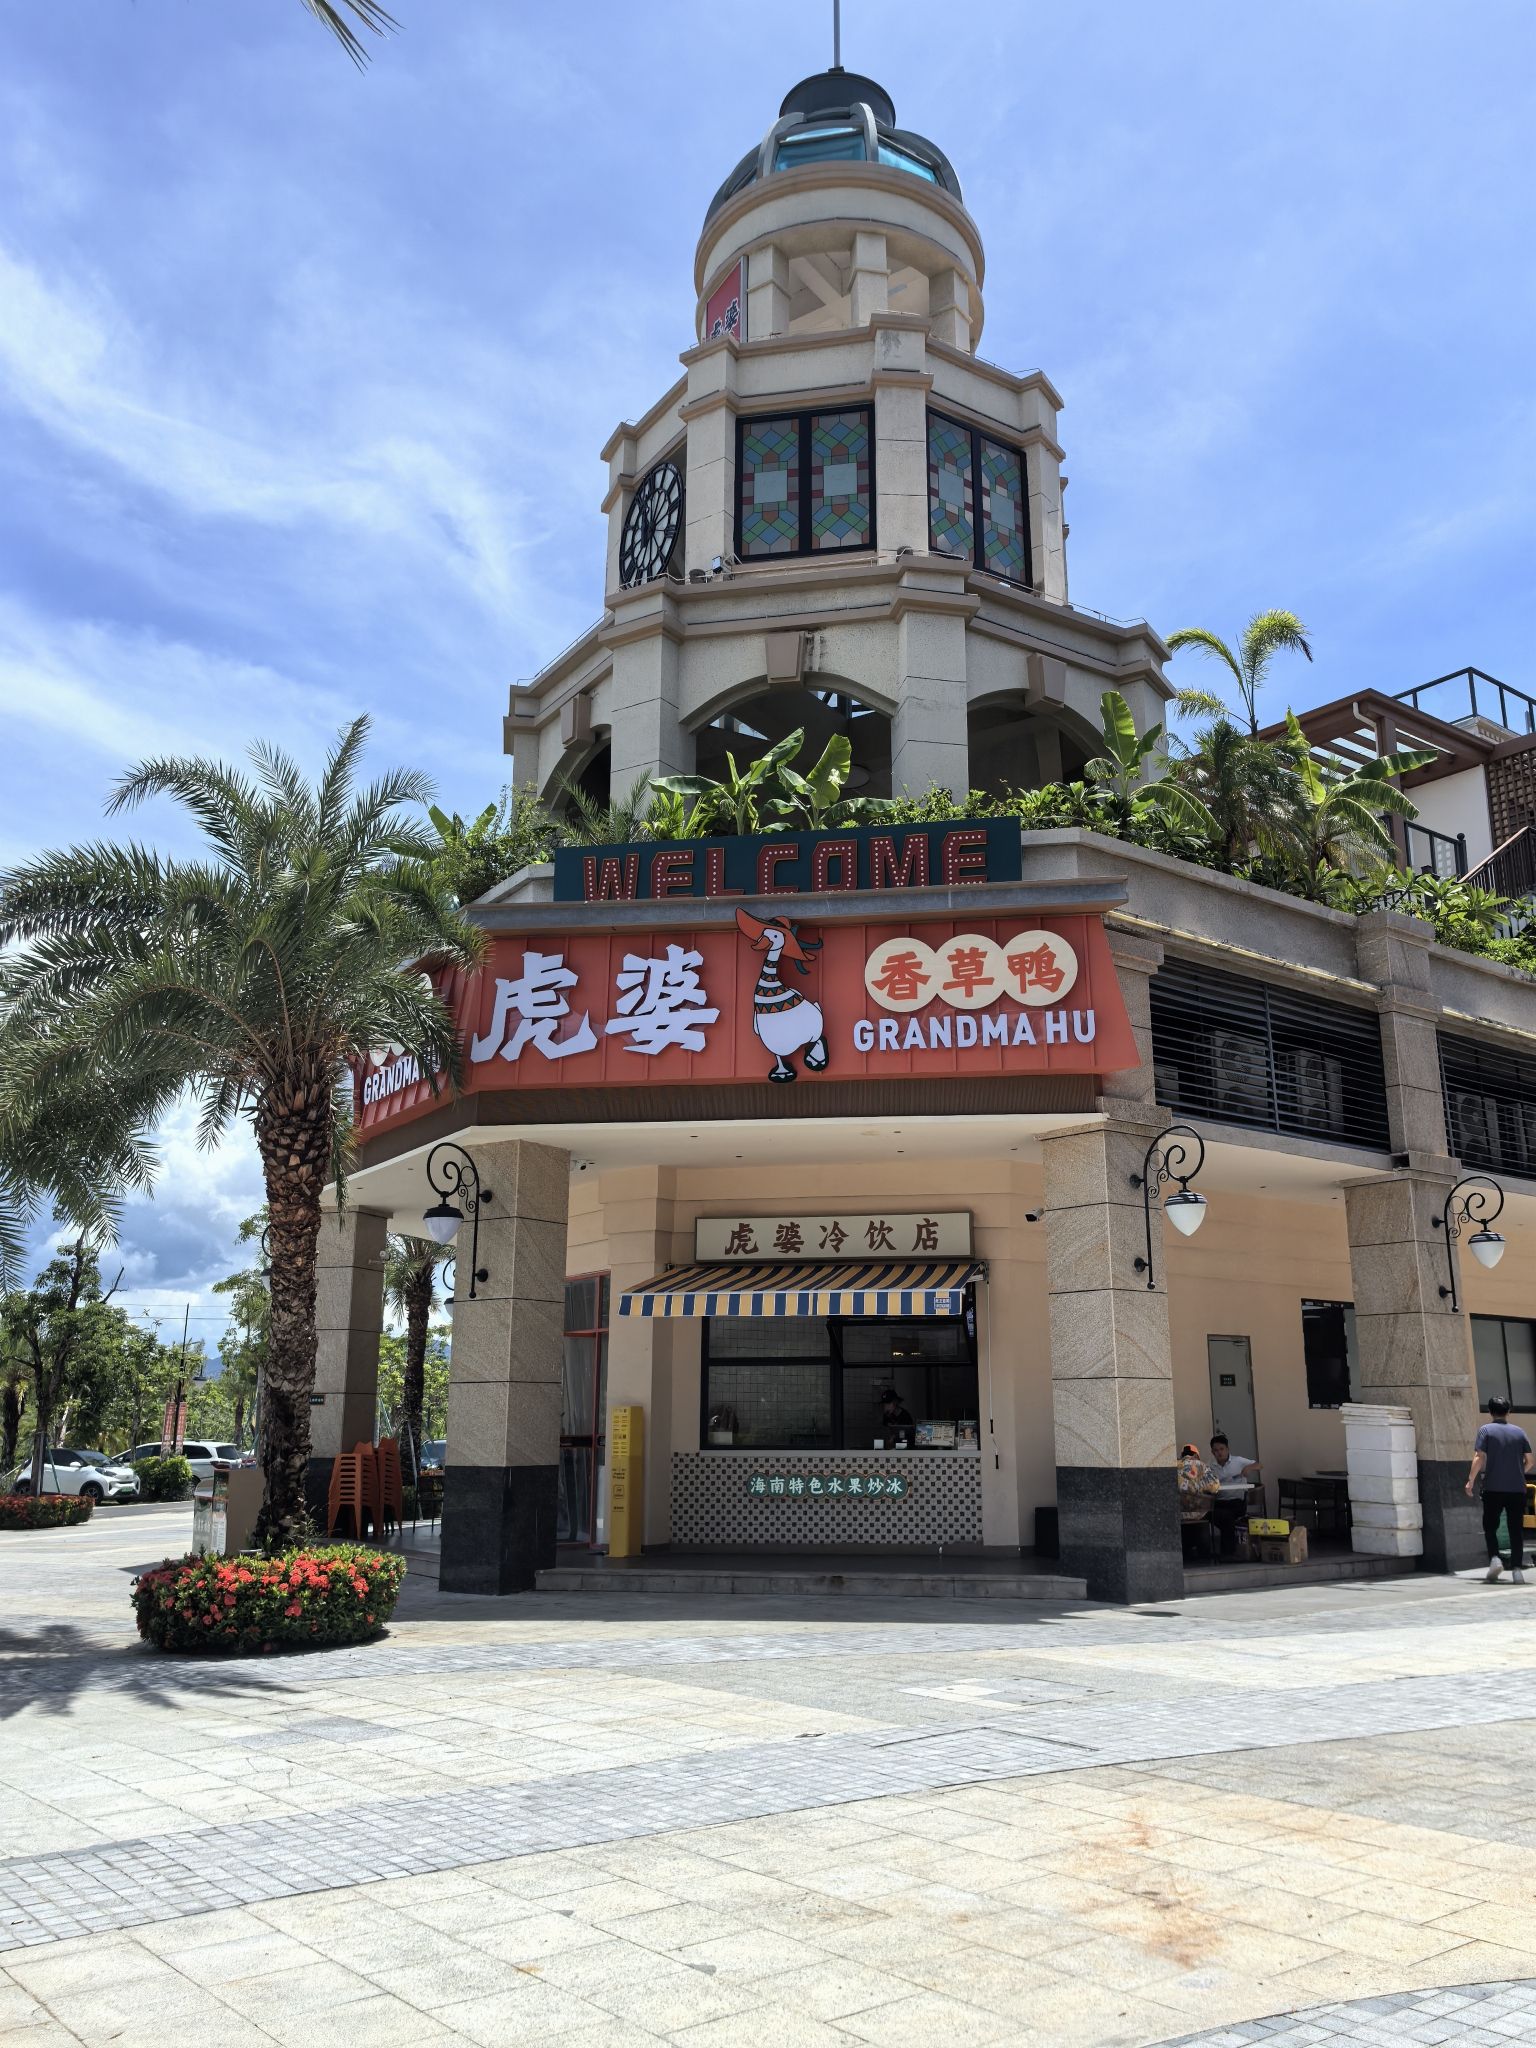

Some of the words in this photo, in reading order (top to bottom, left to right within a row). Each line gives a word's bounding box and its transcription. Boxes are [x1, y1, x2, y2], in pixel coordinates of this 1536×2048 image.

[582, 829, 988, 901] WELCOME
[871, 942, 1066, 1001] 香草鸭
[470, 943, 721, 1063] 虎婆
[853, 1012, 1037, 1052] GRANDMA
[1045, 1009, 1096, 1044] HU
[363, 1055, 420, 1105] GRANDMA
[724, 1218, 939, 1255] 虎婆冷饮店
[750, 1476, 903, 1495] 海南特色水果炒冰
